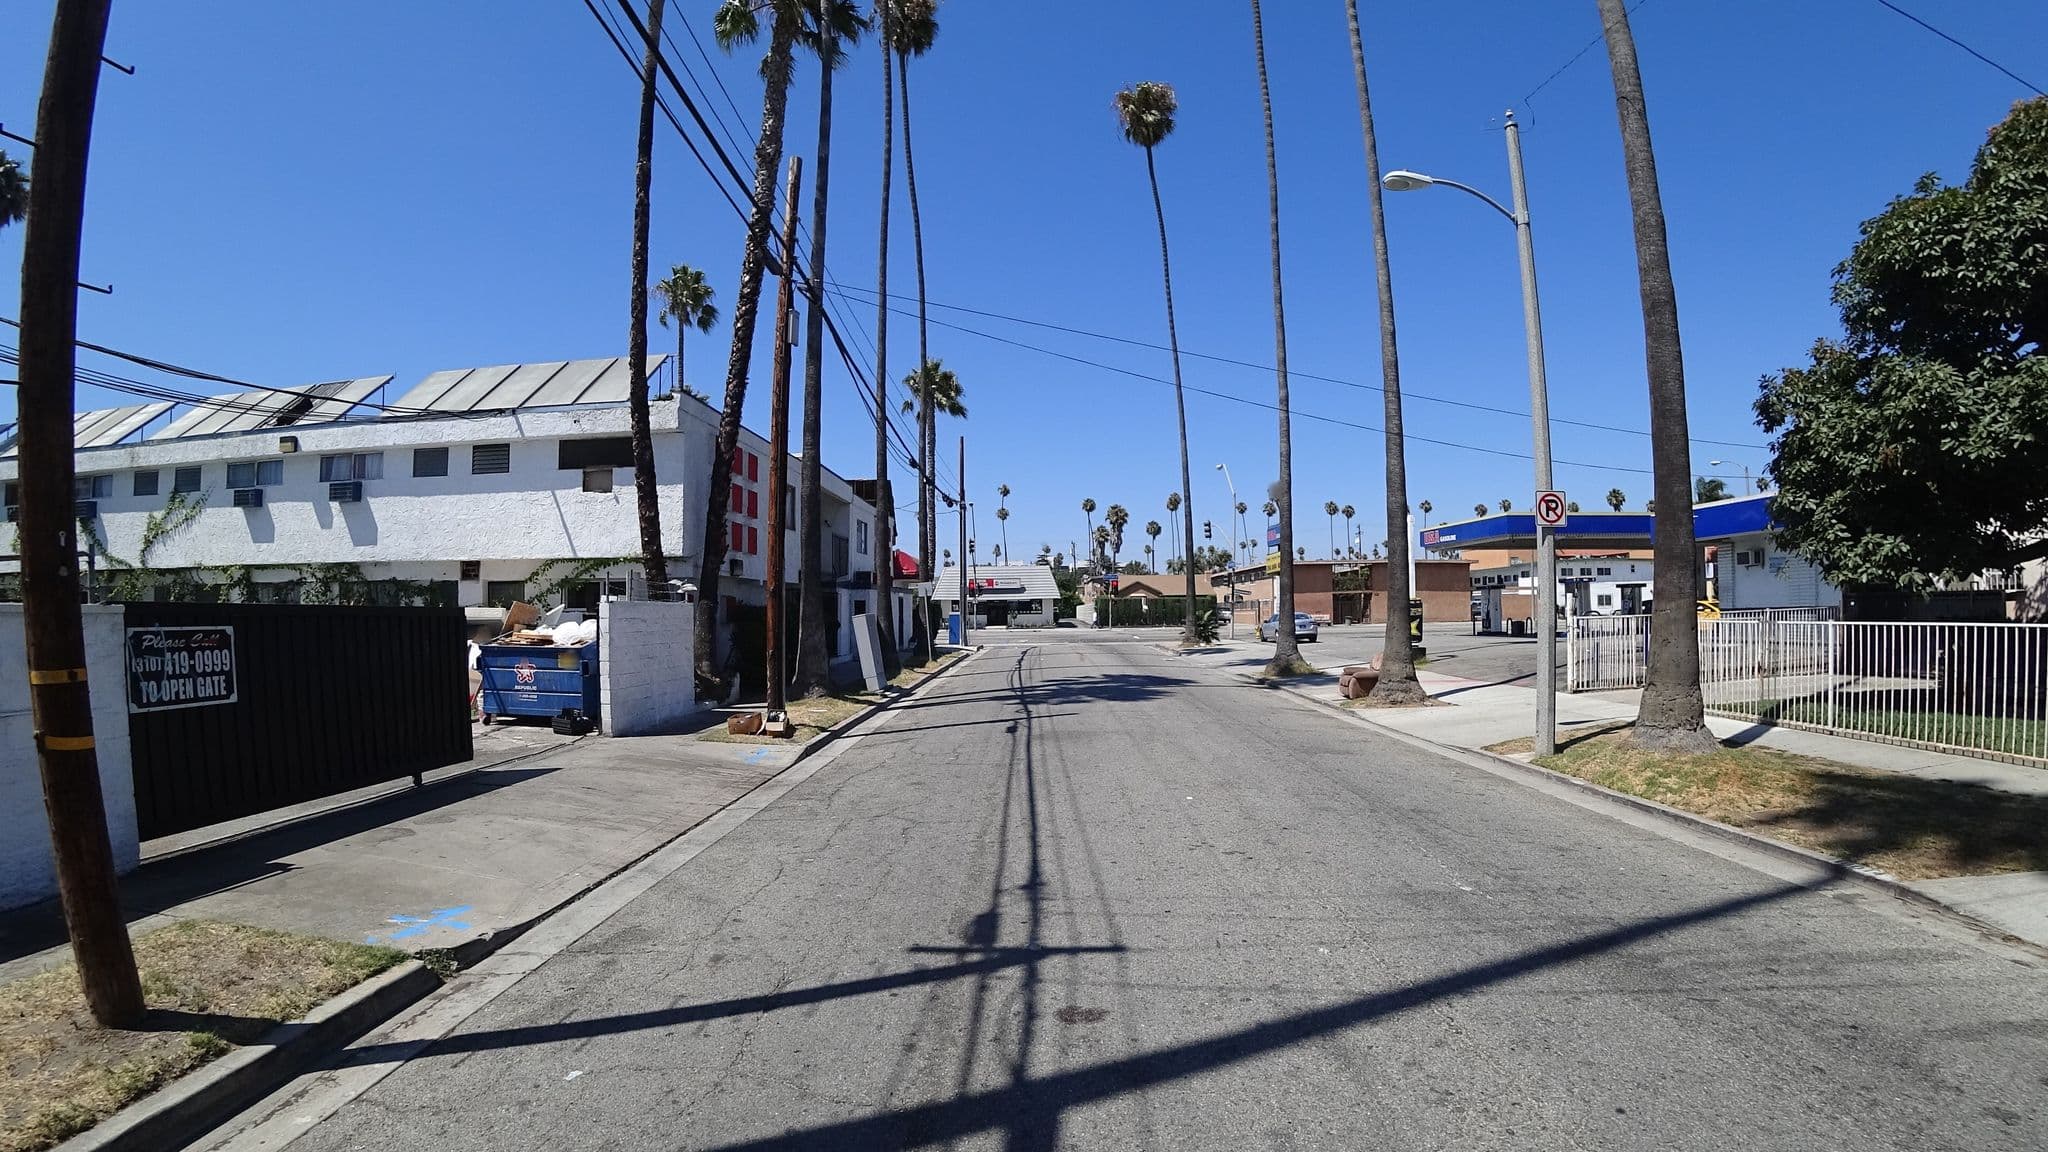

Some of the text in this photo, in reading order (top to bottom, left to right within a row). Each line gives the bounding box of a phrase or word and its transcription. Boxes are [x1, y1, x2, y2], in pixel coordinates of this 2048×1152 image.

[142, 634, 185, 649] Please
[164, 649, 231, 675] 419-0999
[141, 675, 227, 703] TO OPEN GATE
